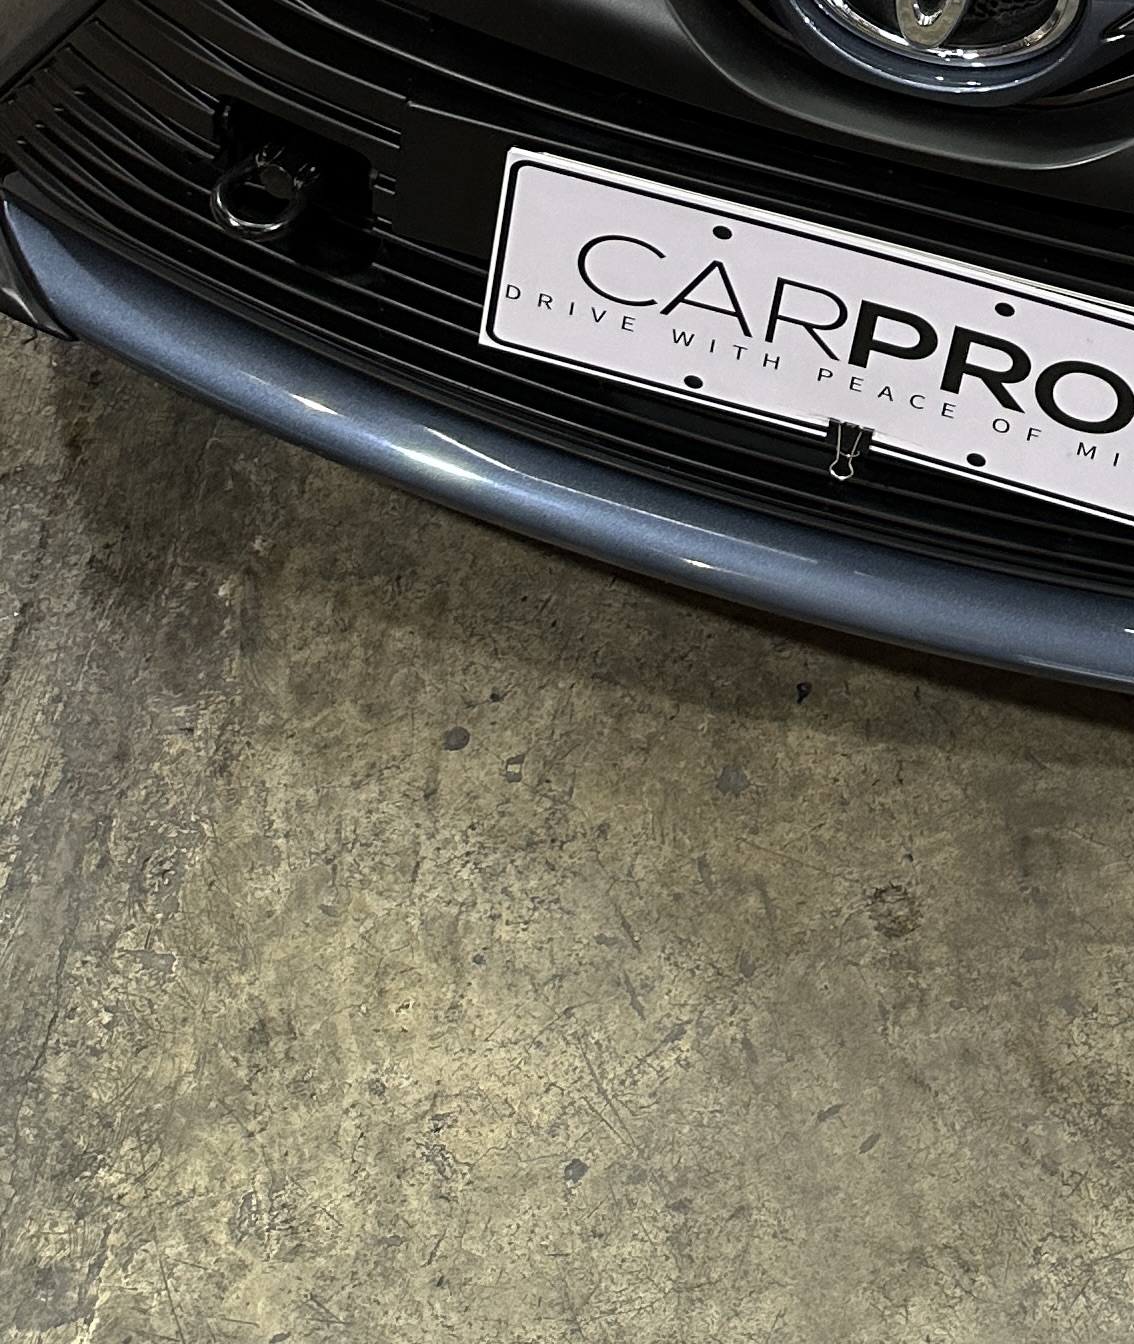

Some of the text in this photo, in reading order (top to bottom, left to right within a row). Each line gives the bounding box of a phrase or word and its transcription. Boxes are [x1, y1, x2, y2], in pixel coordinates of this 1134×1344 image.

[505, 284, 636, 332] DRIVE
[672, 328, 781, 370] WITH
[817, 367, 957, 419] PEACE
[992, 418, 1042, 442] OF
